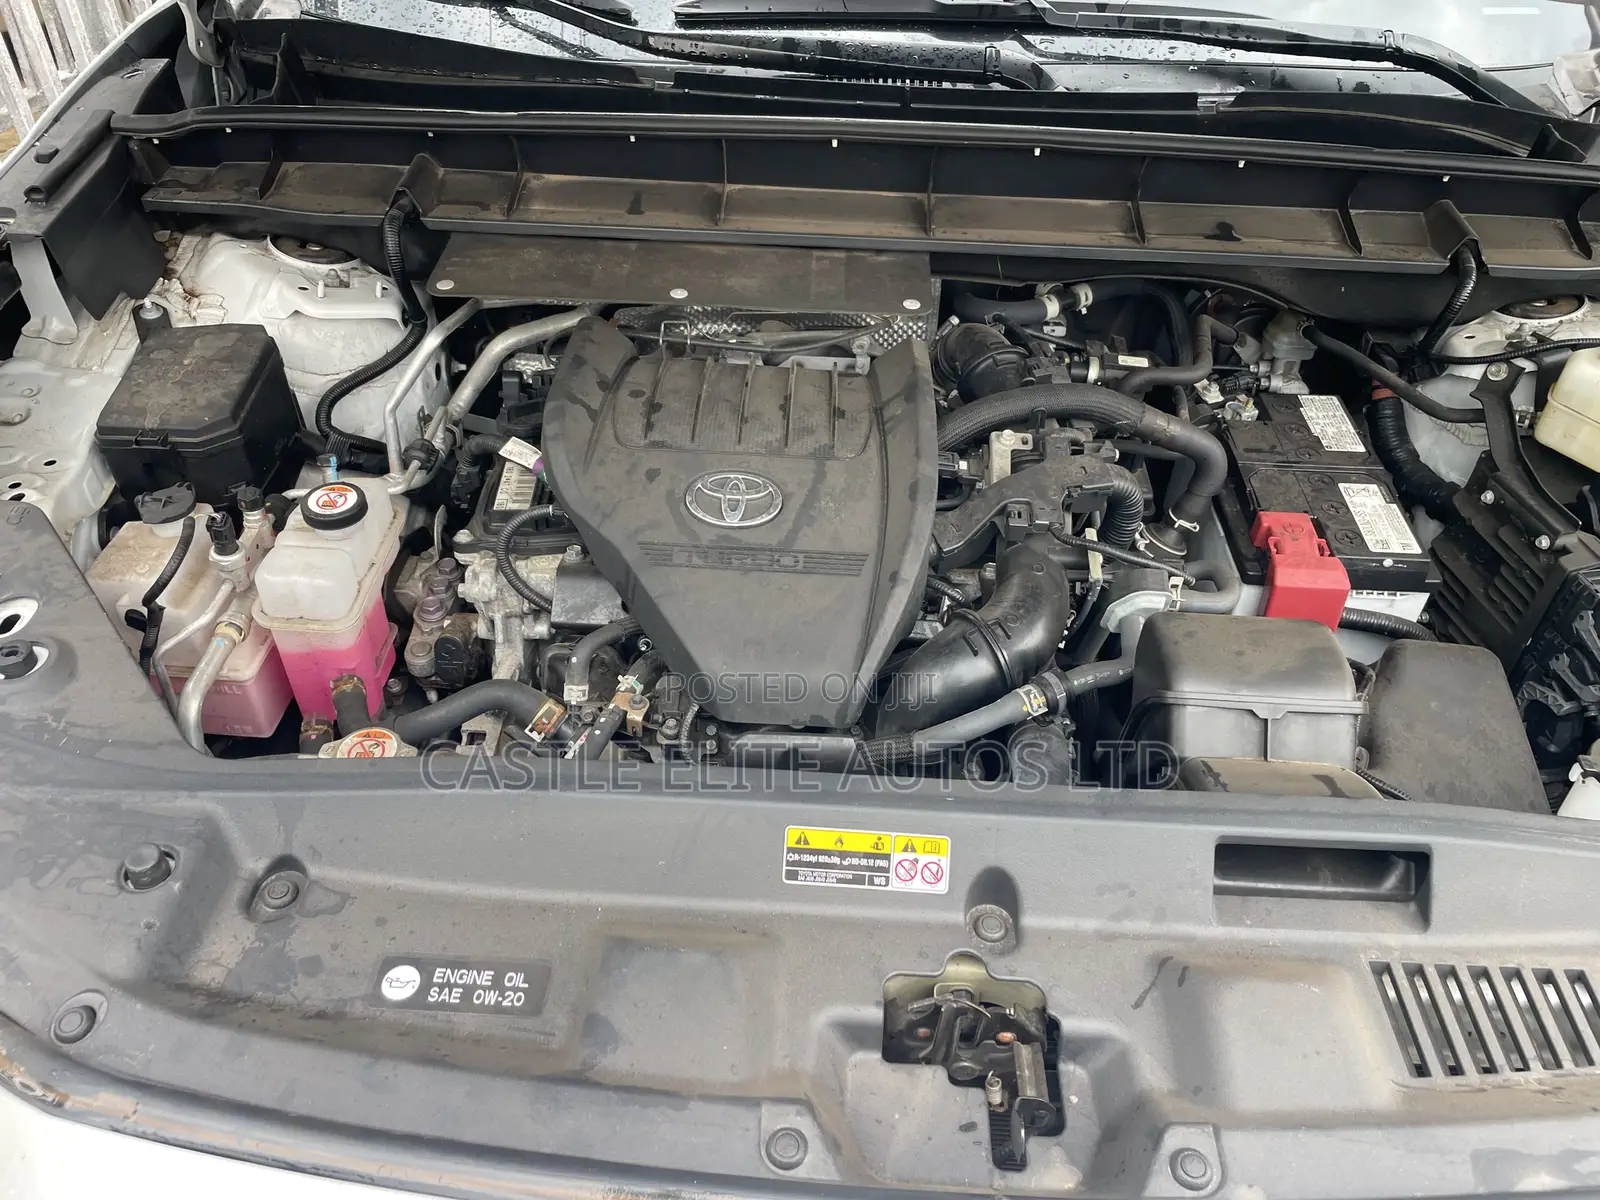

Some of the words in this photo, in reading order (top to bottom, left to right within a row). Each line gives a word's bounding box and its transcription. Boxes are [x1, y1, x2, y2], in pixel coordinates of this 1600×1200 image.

[827, 872, 853, 880] CORPORATION
[432, 967, 495, 986] ENGINE
[503, 972, 530, 988] OIL
[427, 987, 463, 1004] SAE
[472, 989, 525, 1007] 0W-20
